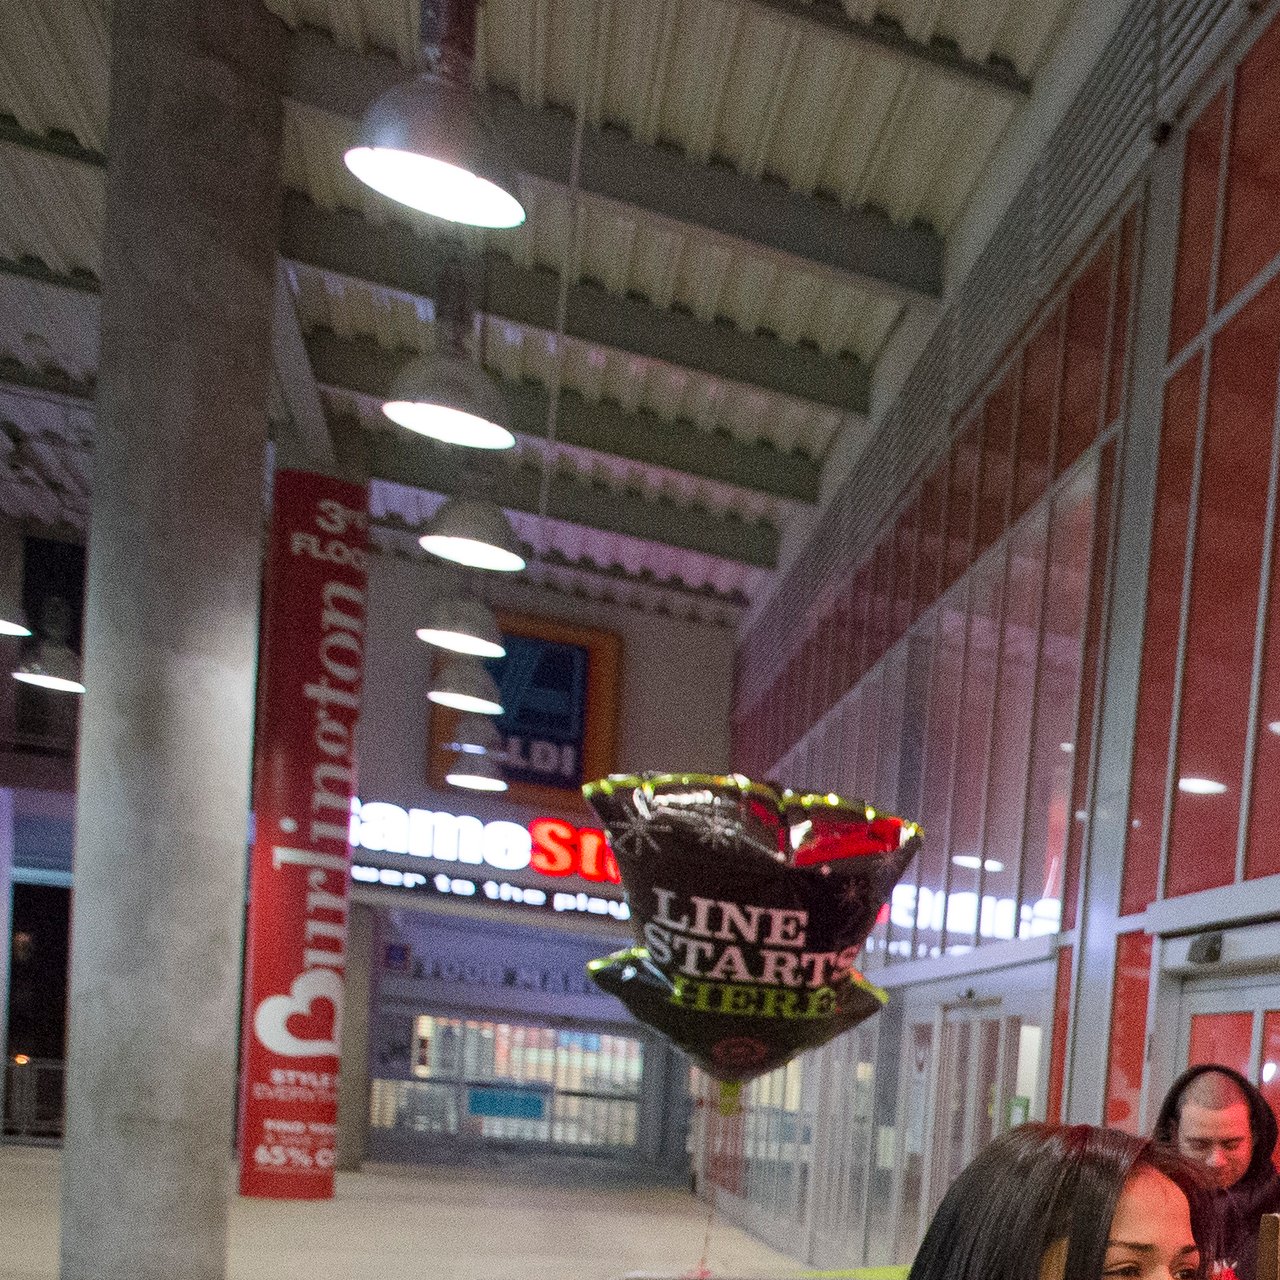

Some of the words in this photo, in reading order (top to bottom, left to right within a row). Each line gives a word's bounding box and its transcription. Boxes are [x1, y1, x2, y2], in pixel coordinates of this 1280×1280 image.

[350, 796, 622, 885] ameSt
[434, 873, 476, 896] to
[483, 880, 547, 906] the
[652, 887, 810, 948] LINE
[645, 922, 862, 989] STARTS
[673, 975, 838, 1019] HERE
